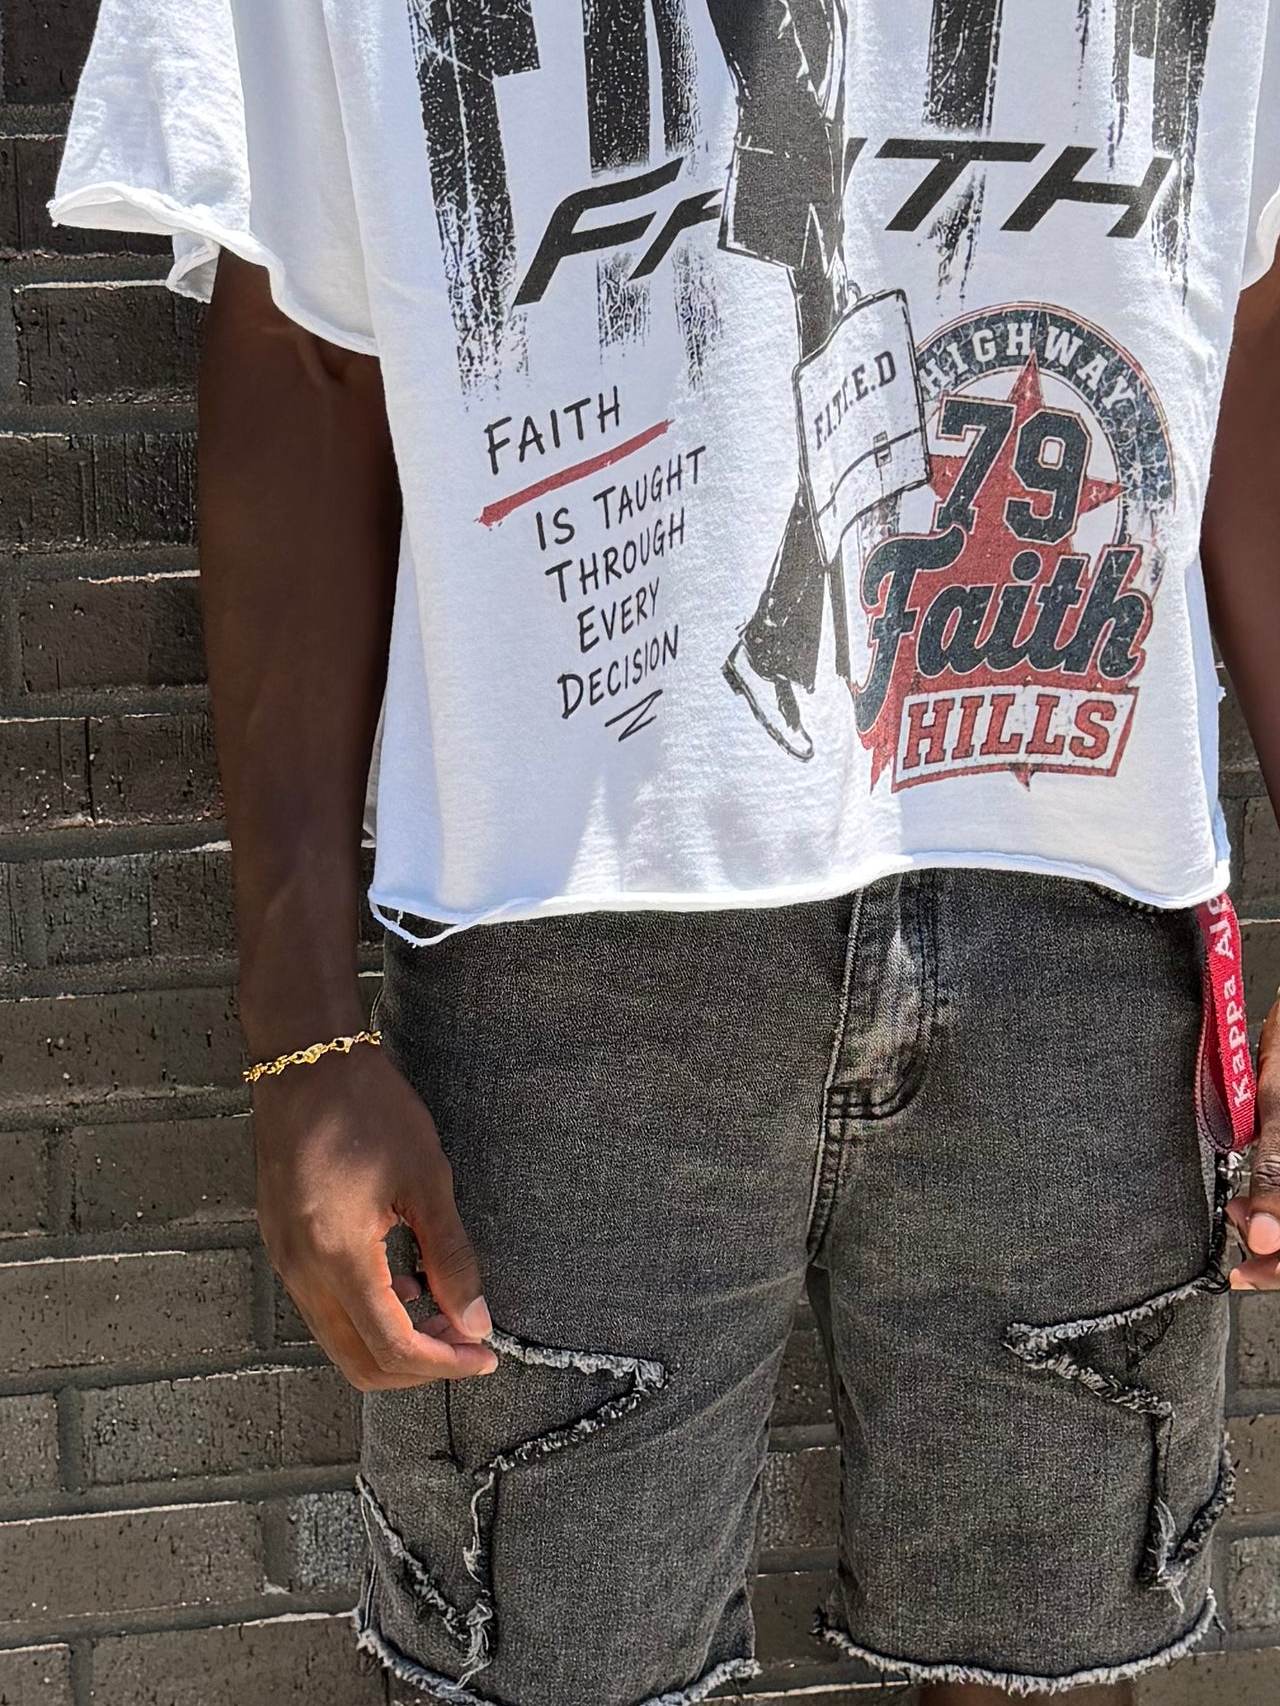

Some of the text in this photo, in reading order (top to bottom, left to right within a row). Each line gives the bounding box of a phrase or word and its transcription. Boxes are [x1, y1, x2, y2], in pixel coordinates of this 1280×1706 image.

[920, 322, 1136, 410] HIGHWAY
[484, 385, 621, 475] FAITH
[935, 394, 1093, 545] 79
[536, 445, 707, 551] IS TAUGHT
[545, 506, 685, 603] THROUGH
[577, 576, 660, 653] EVERY
[855, 524, 1152, 734] Faith
[557, 624, 679, 719] DECISION
[902, 693, 1117, 771] HILLS
[1223, 974, 1252, 1108] Kappa
